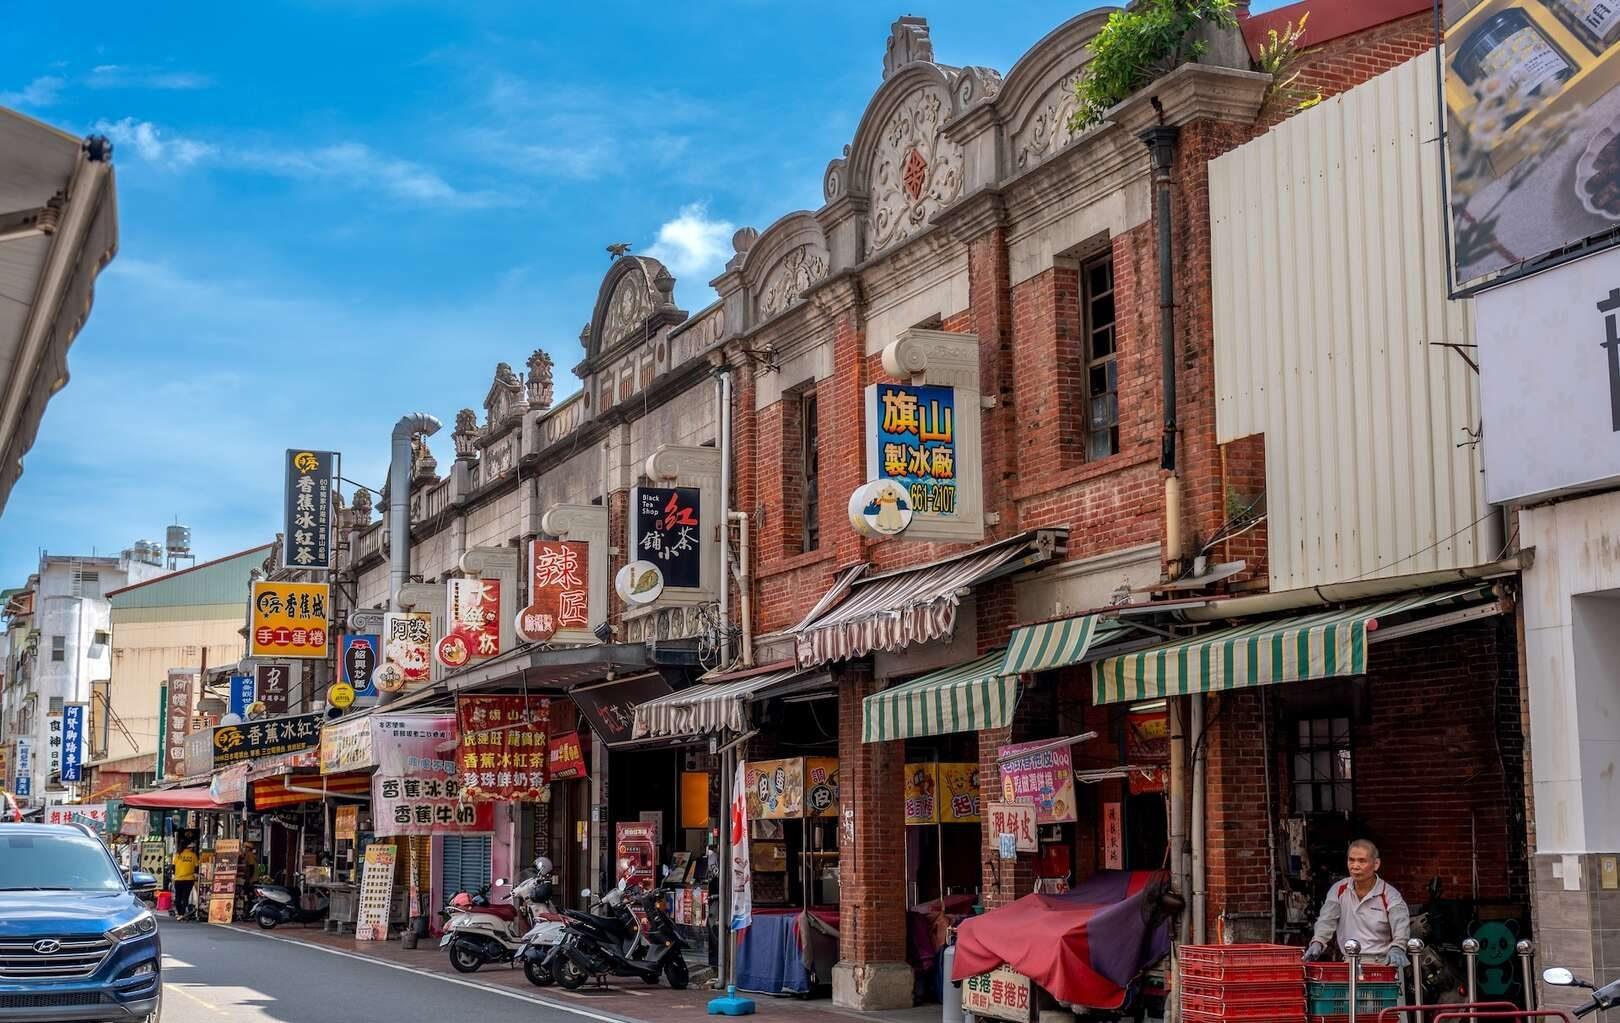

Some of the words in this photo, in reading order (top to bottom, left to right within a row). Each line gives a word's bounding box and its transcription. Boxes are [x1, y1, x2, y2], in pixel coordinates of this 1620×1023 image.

[883, 389, 953, 443] 旗山
[885, 443, 953, 478] 製冰廠
[642, 494, 660, 502] Black
[642, 507, 659, 516] Shop
[910, 483, 955, 513] 661-2107
[294, 475, 316, 565] 香蕉冰紅茶
[536, 544, 588, 626] 辣匠
[257, 628, 325, 646] 手工蛋捲
[391, 617, 430, 641] 阿婆
[354, 649, 366, 689] 紹興炒飯
[463, 752, 545, 769] 香蕉冰紅茶
[464, 771, 545, 787] 珍珠鮮奶茶
[394, 805, 474, 824] 香蕉牛奶
[991, 979, 1028, 1010] 春捲皮
